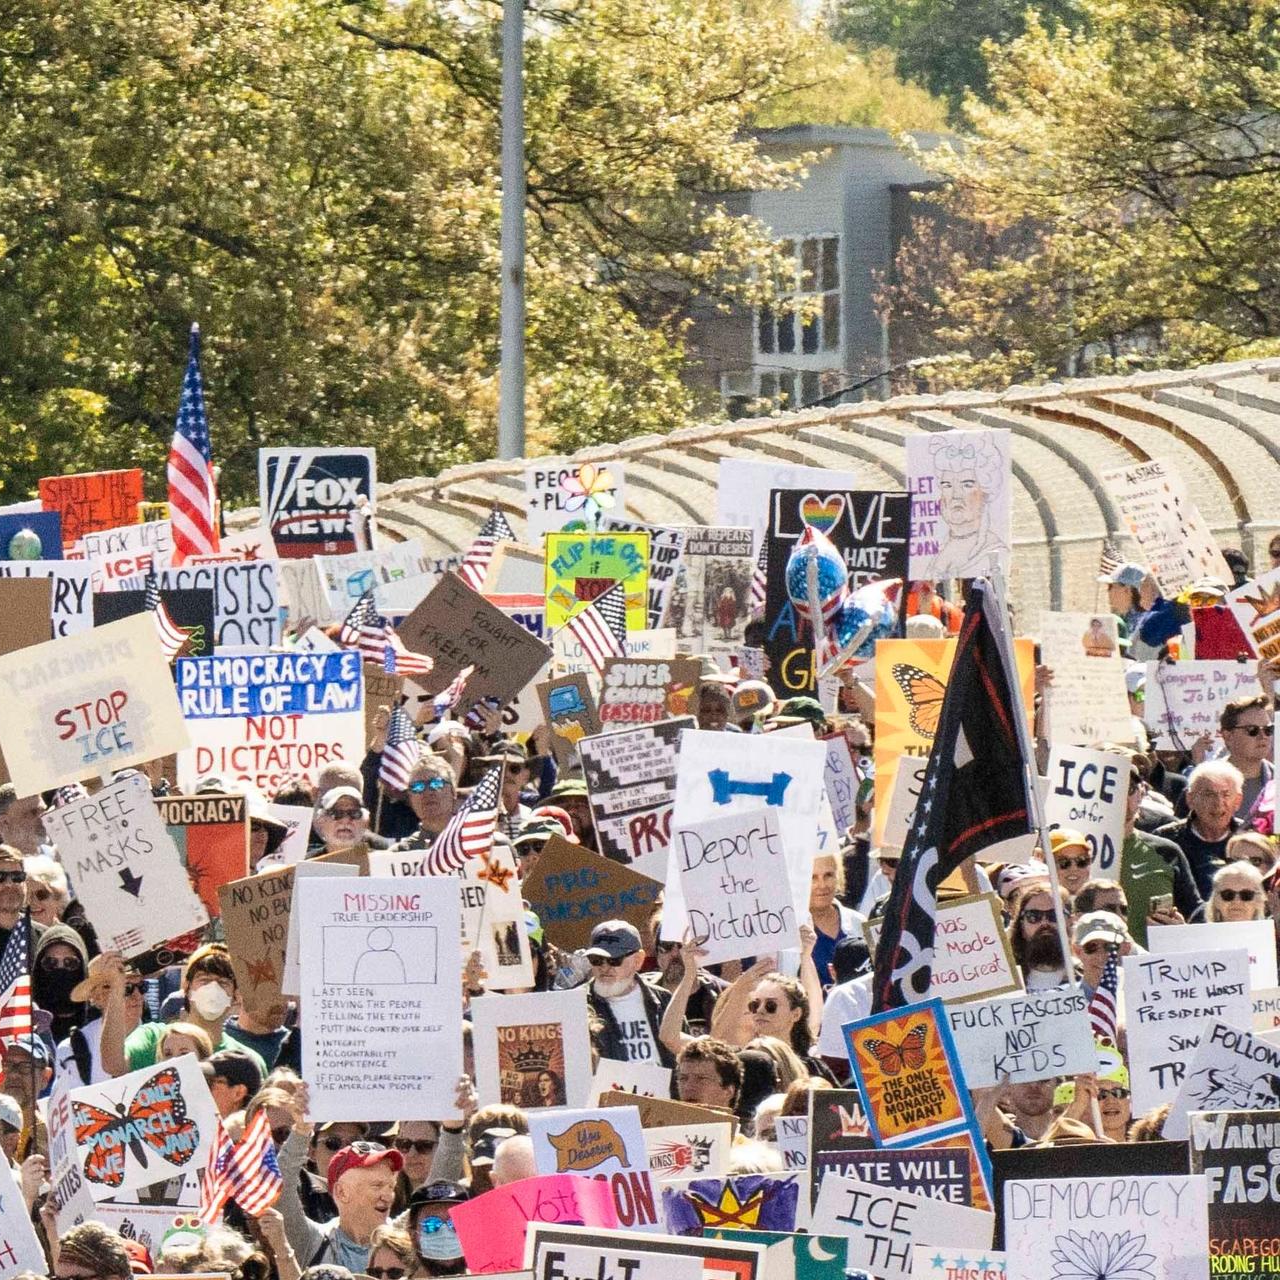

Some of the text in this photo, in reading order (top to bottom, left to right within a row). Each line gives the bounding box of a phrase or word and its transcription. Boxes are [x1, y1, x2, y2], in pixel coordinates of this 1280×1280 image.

[297, 478, 362, 505] FOX
[908, 477, 934, 494] LET
[591, 539, 615, 556] ME
[184, 684, 359, 713] RULE OF LAW
[55, 690, 128, 740] STOP
[245, 715, 302, 740] NOT
[76, 721, 134, 763] ICE
[1055, 760, 1119, 799] ICE
[679, 818, 779, 872] Deport
[720, 876, 760, 896] the
[344, 893, 420, 912] MISSING
[332, 911, 433, 923] TRUE LEADERSHIP
[687, 902, 794, 948] Dictator
[1141, 960, 1227, 982] TRUMP
[950, 995, 1086, 1030] FUCK FASCISTS
[1138, 1004, 1227, 1022] PRESIDENT
[1006, 1023, 1039, 1050] NOT
[994, 1045, 1066, 1079] KIDS
[883, 1070, 934, 1090] THE ONLY
[883, 1081, 940, 1101] ORANGE
[885, 1091, 946, 1117] MONARCH
[902, 1103, 943, 1123] WANT
[824, 1160, 963, 1182] HATE WILL
[836, 1189, 918, 1236] ICE
[1010, 1181, 1191, 1221] DEMOCRACY
